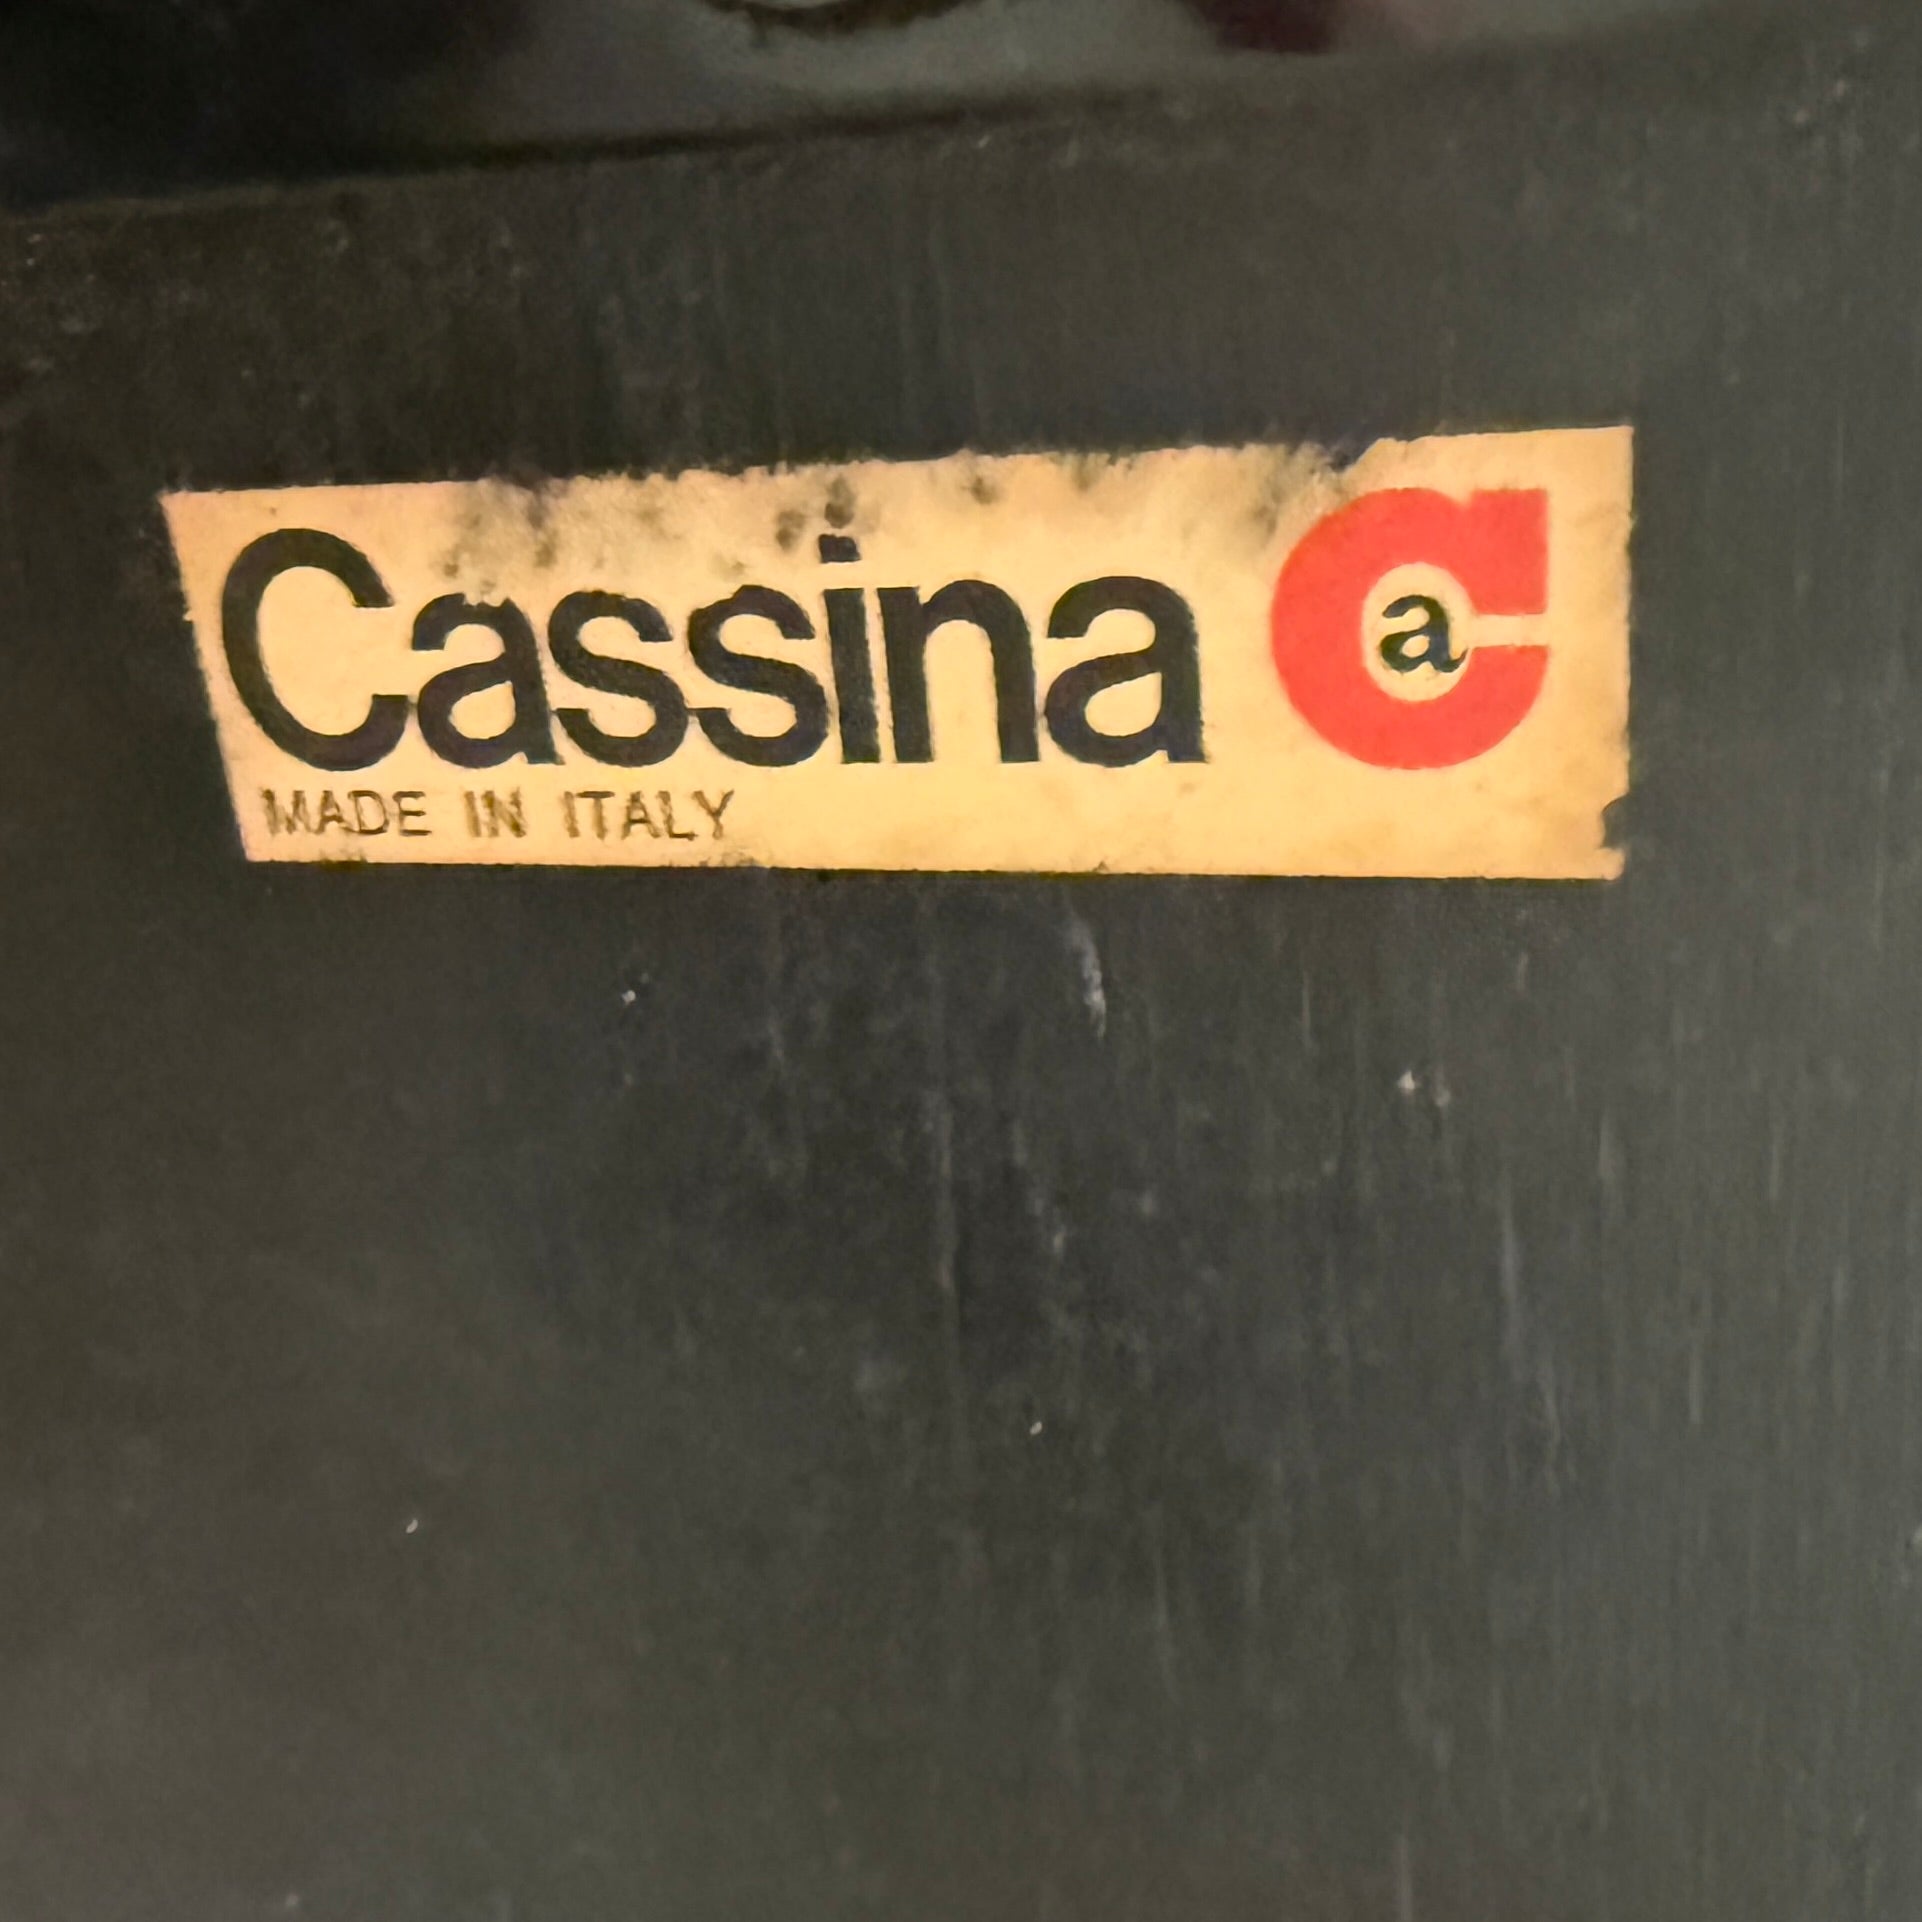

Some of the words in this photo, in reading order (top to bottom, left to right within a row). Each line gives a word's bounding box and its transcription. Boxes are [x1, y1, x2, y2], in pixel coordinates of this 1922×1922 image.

[222, 528, 1206, 772] Cassina
[264, 789, 431, 835] MADE
[466, 789, 526, 838] IN
[564, 790, 735, 840] ITALY
